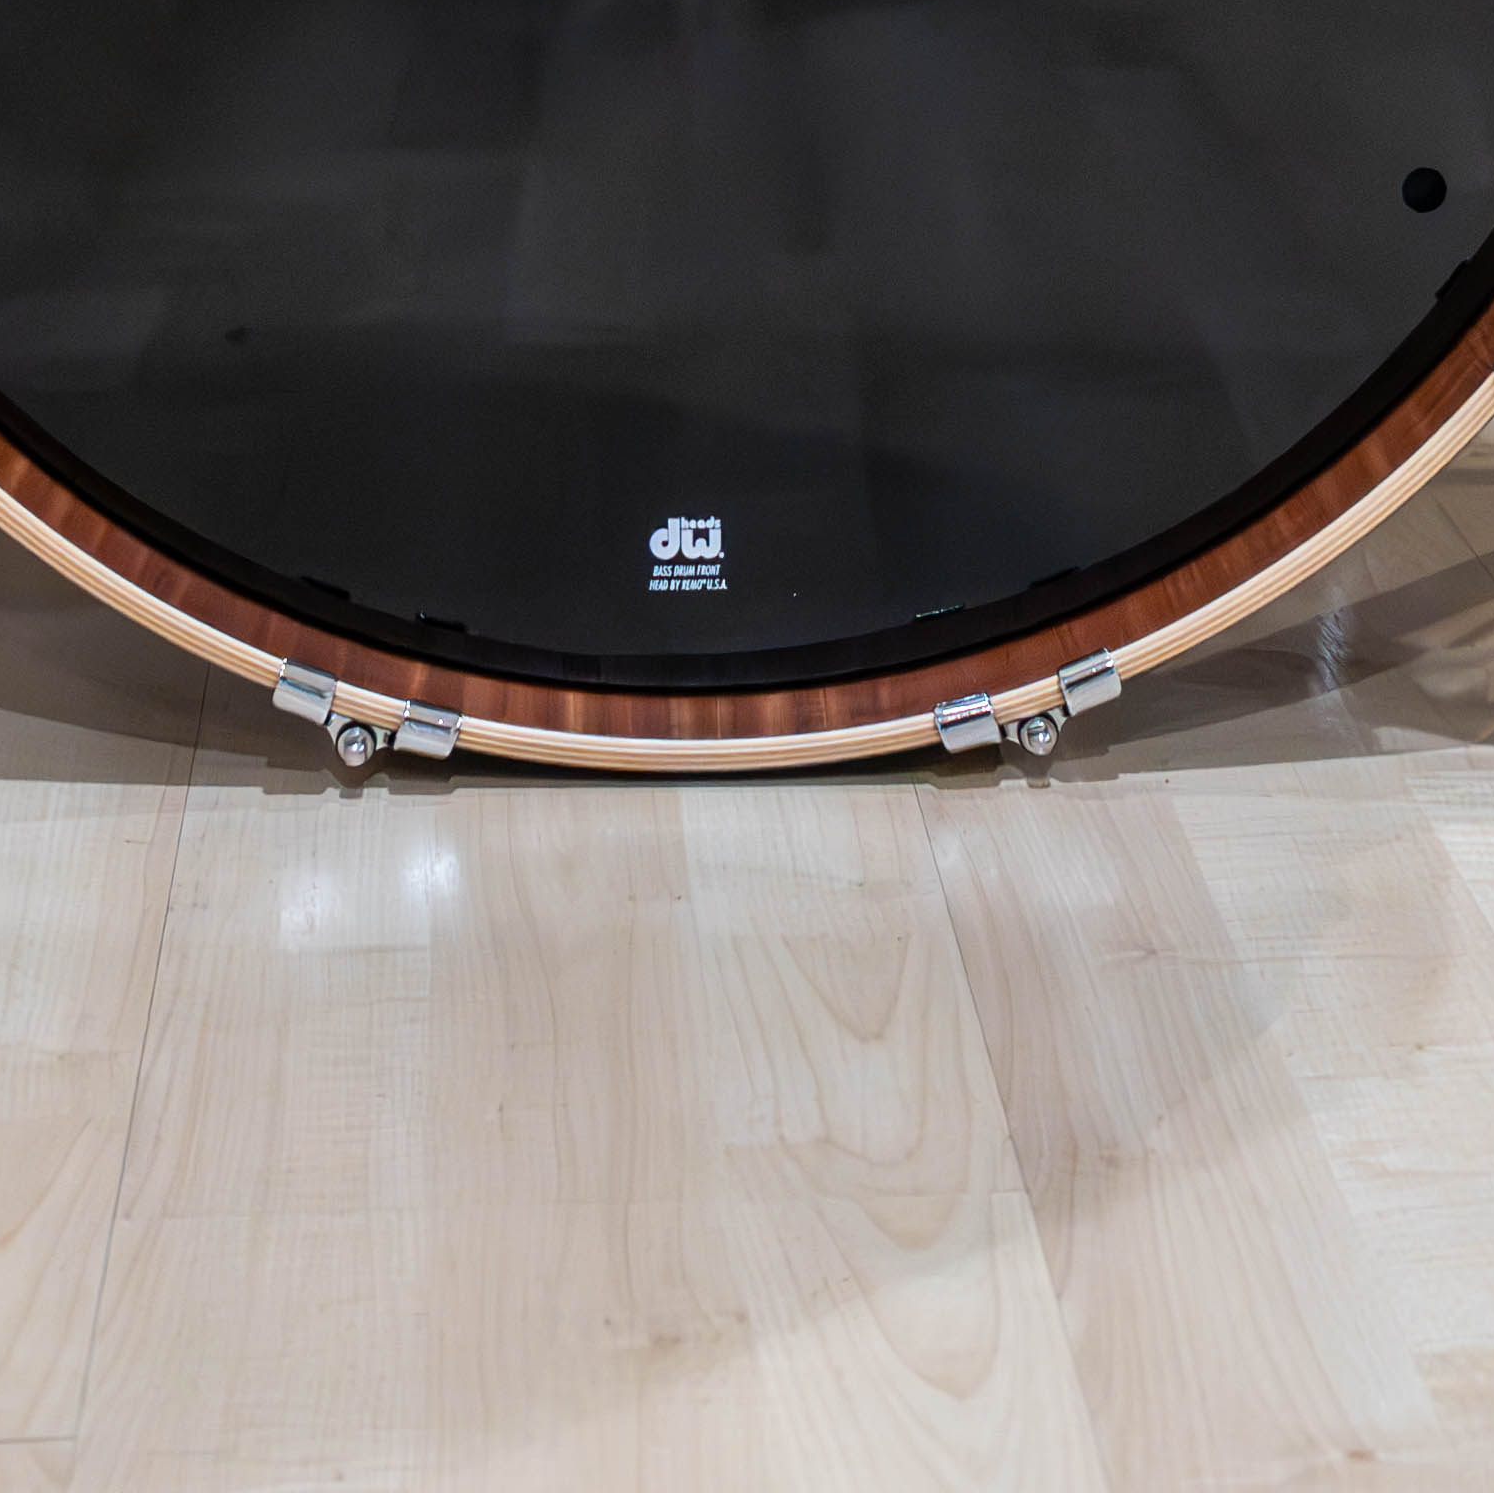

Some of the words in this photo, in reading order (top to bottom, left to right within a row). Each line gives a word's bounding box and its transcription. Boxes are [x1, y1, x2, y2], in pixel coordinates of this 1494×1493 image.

[681, 515, 722, 529] heads
[649, 517, 722, 561] dw
[652, 564, 674, 577] BASS
[673, 564, 696, 577] DRUM
[696, 564, 722, 576] FRONT
[648, 579, 669, 591] HEAD
[670, 579, 681, 591] BY
